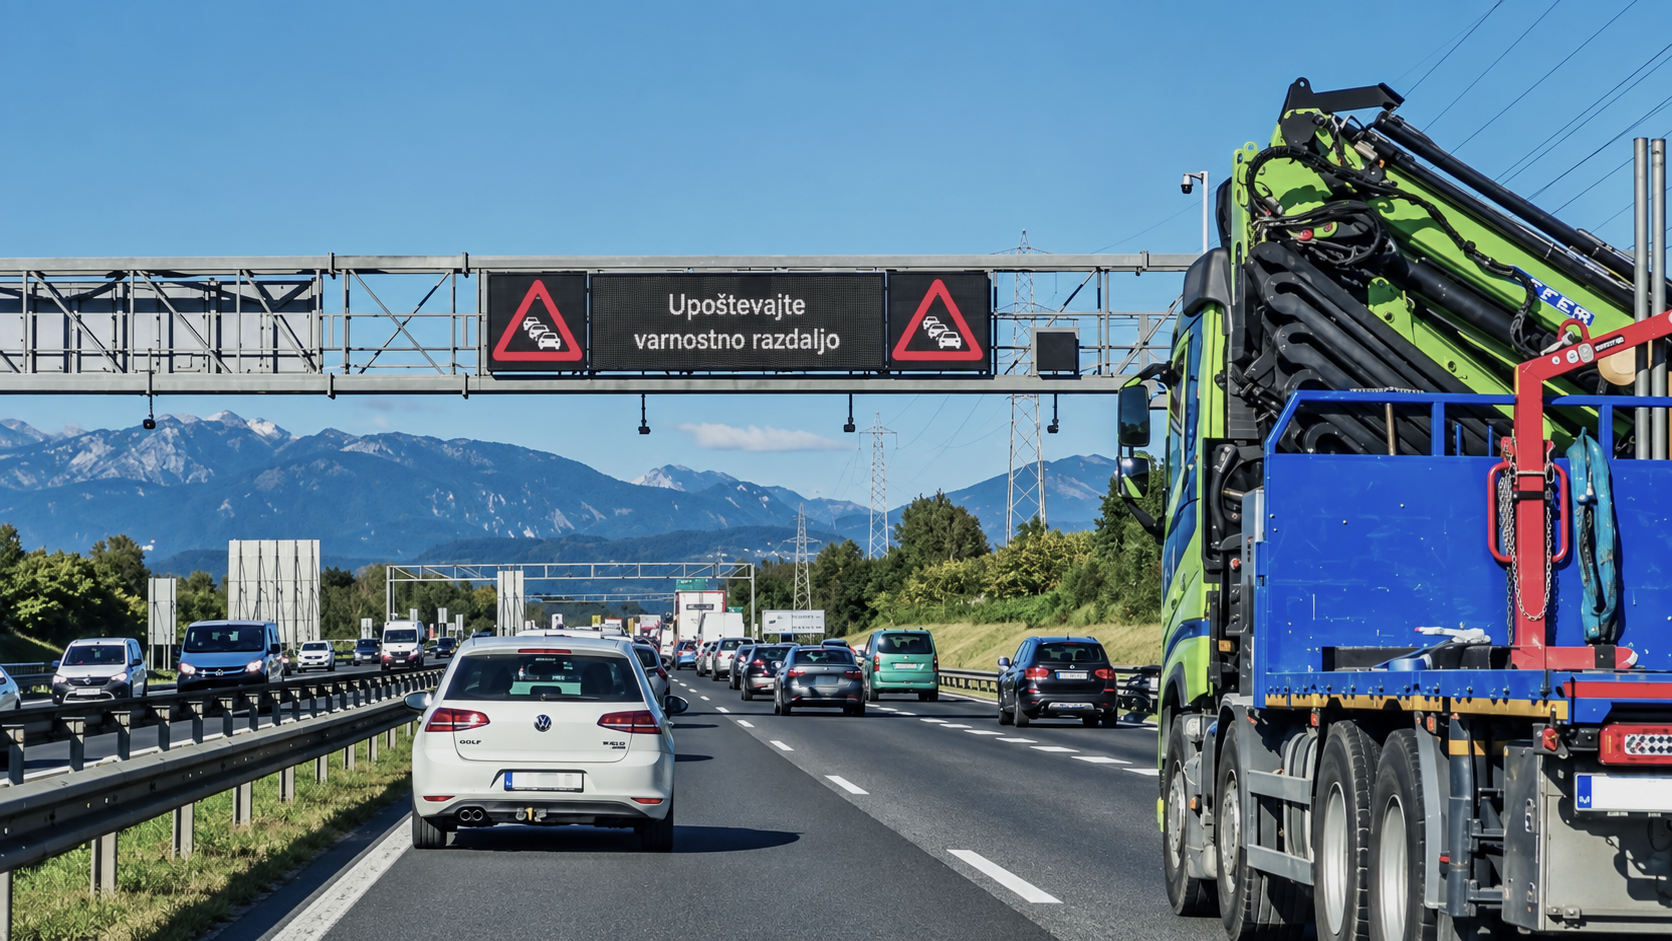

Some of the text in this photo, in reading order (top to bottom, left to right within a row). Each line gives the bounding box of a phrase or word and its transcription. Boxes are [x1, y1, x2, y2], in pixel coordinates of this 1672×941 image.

[668, 293, 806, 321] Upoštevajte
[634, 328, 840, 355] varnostno razdaljo
